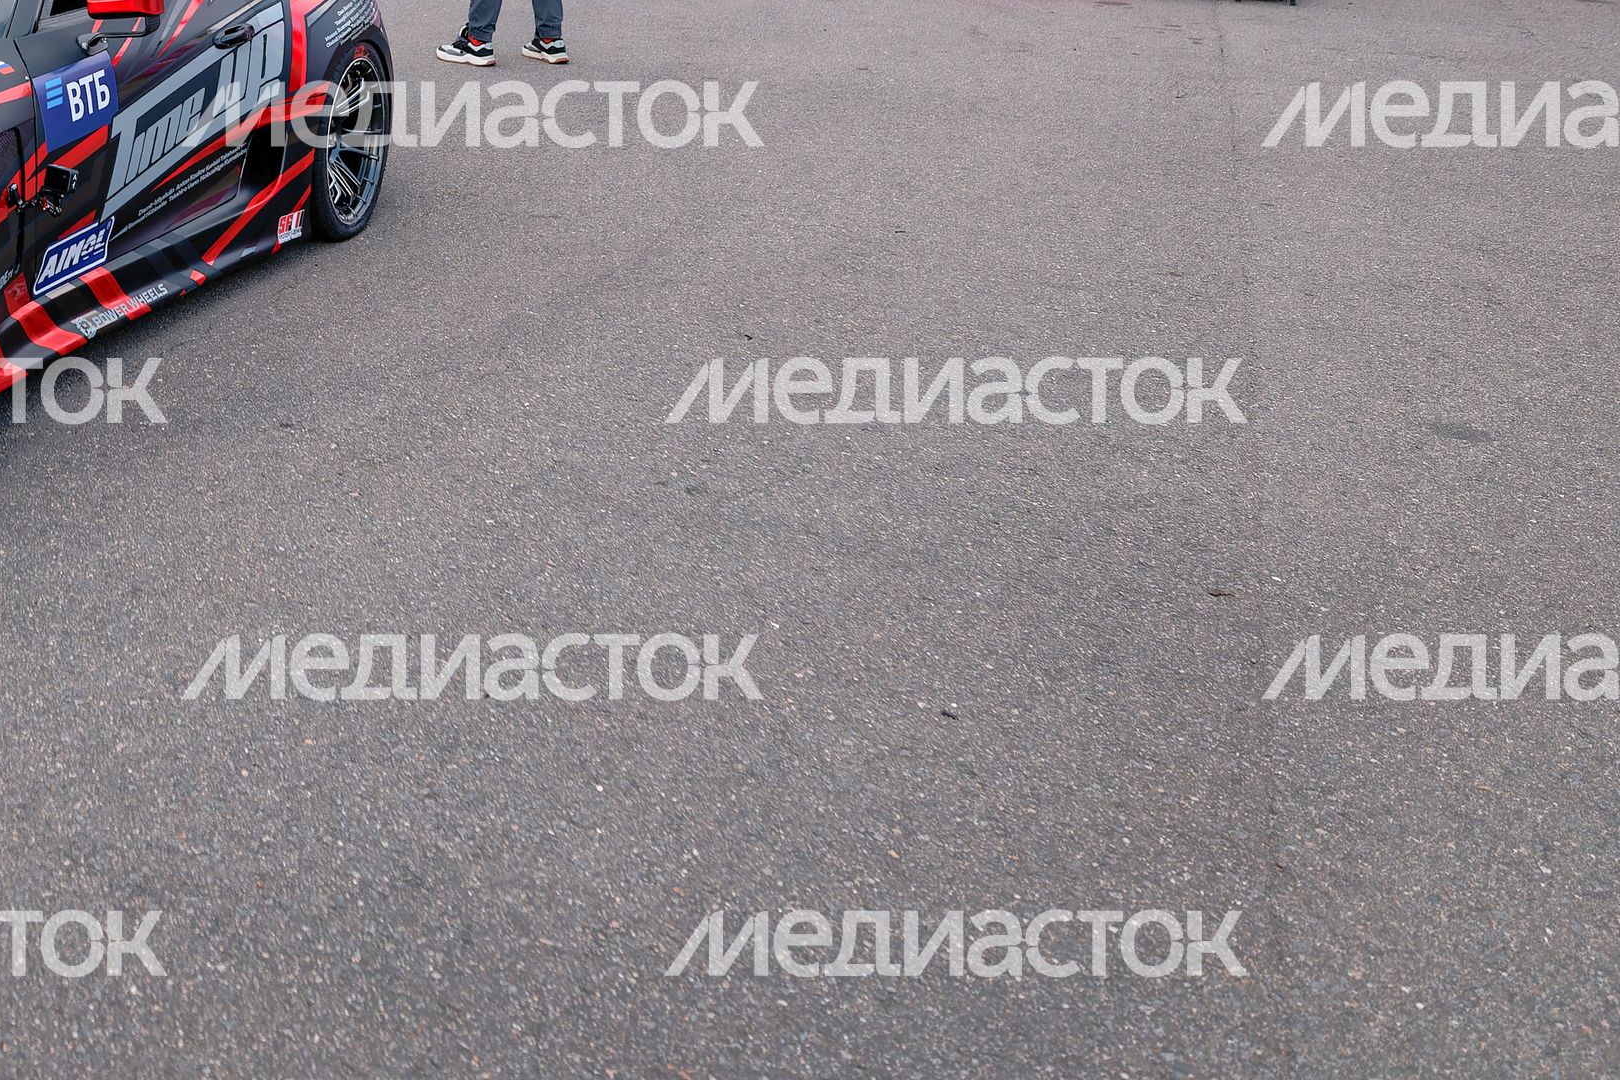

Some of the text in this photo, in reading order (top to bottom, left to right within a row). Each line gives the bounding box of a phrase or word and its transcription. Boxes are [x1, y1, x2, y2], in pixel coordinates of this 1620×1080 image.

[66, 69, 111, 122] ВТБ
[38, 227, 106, 285] AIMOL
[92, 284, 169, 328] POWER WHEELS
